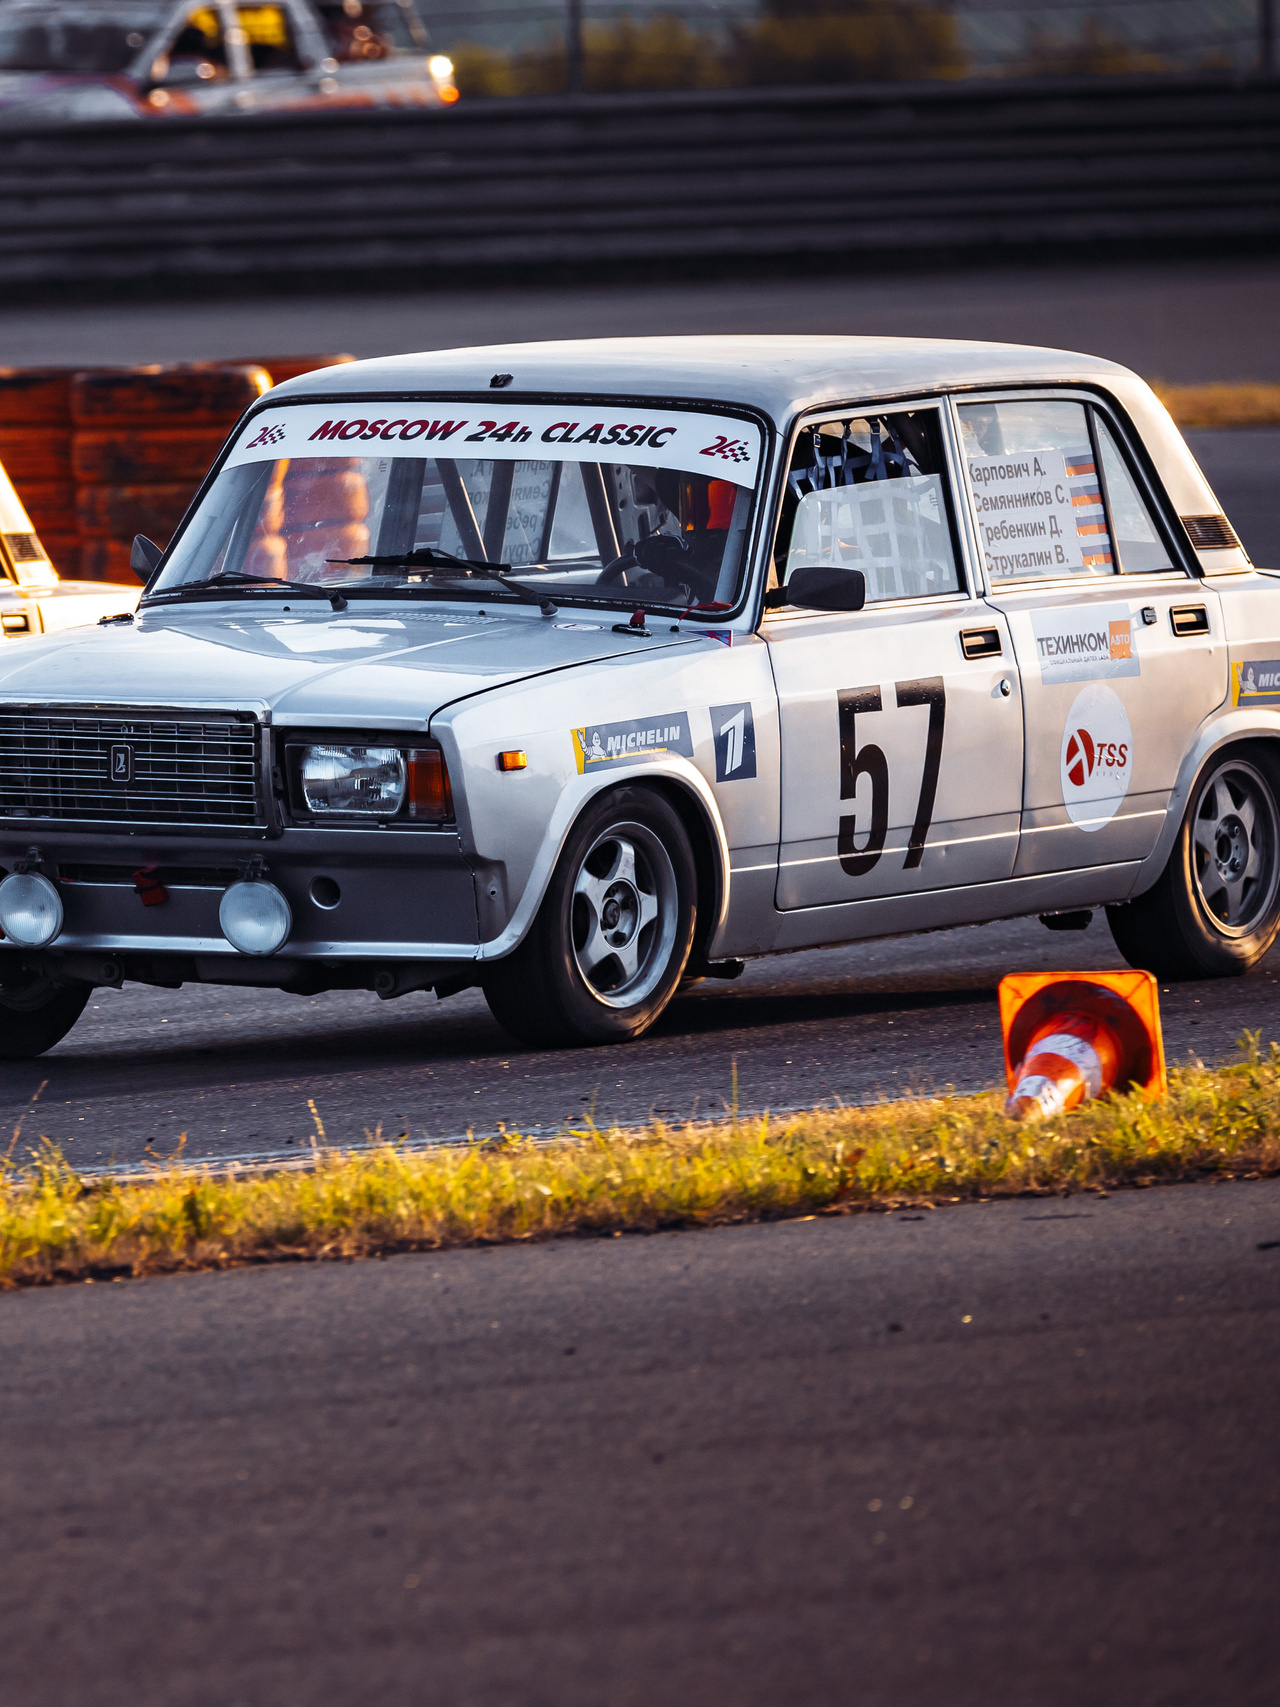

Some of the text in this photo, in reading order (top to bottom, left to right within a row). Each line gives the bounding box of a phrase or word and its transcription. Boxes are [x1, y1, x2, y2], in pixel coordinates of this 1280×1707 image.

[307, 419, 678, 448] MOSCOW 24h CLASSIC
[973, 490, 1053, 512] Семянников
[984, 550, 1053, 575] Струкалин
[1037, 631, 1130, 656] ТЕХИНКОМ АВТО
[606, 725, 681, 751] MICHELIN
[1096, 743, 1128, 768] TSS
[837, 676, 946, 876] 57
